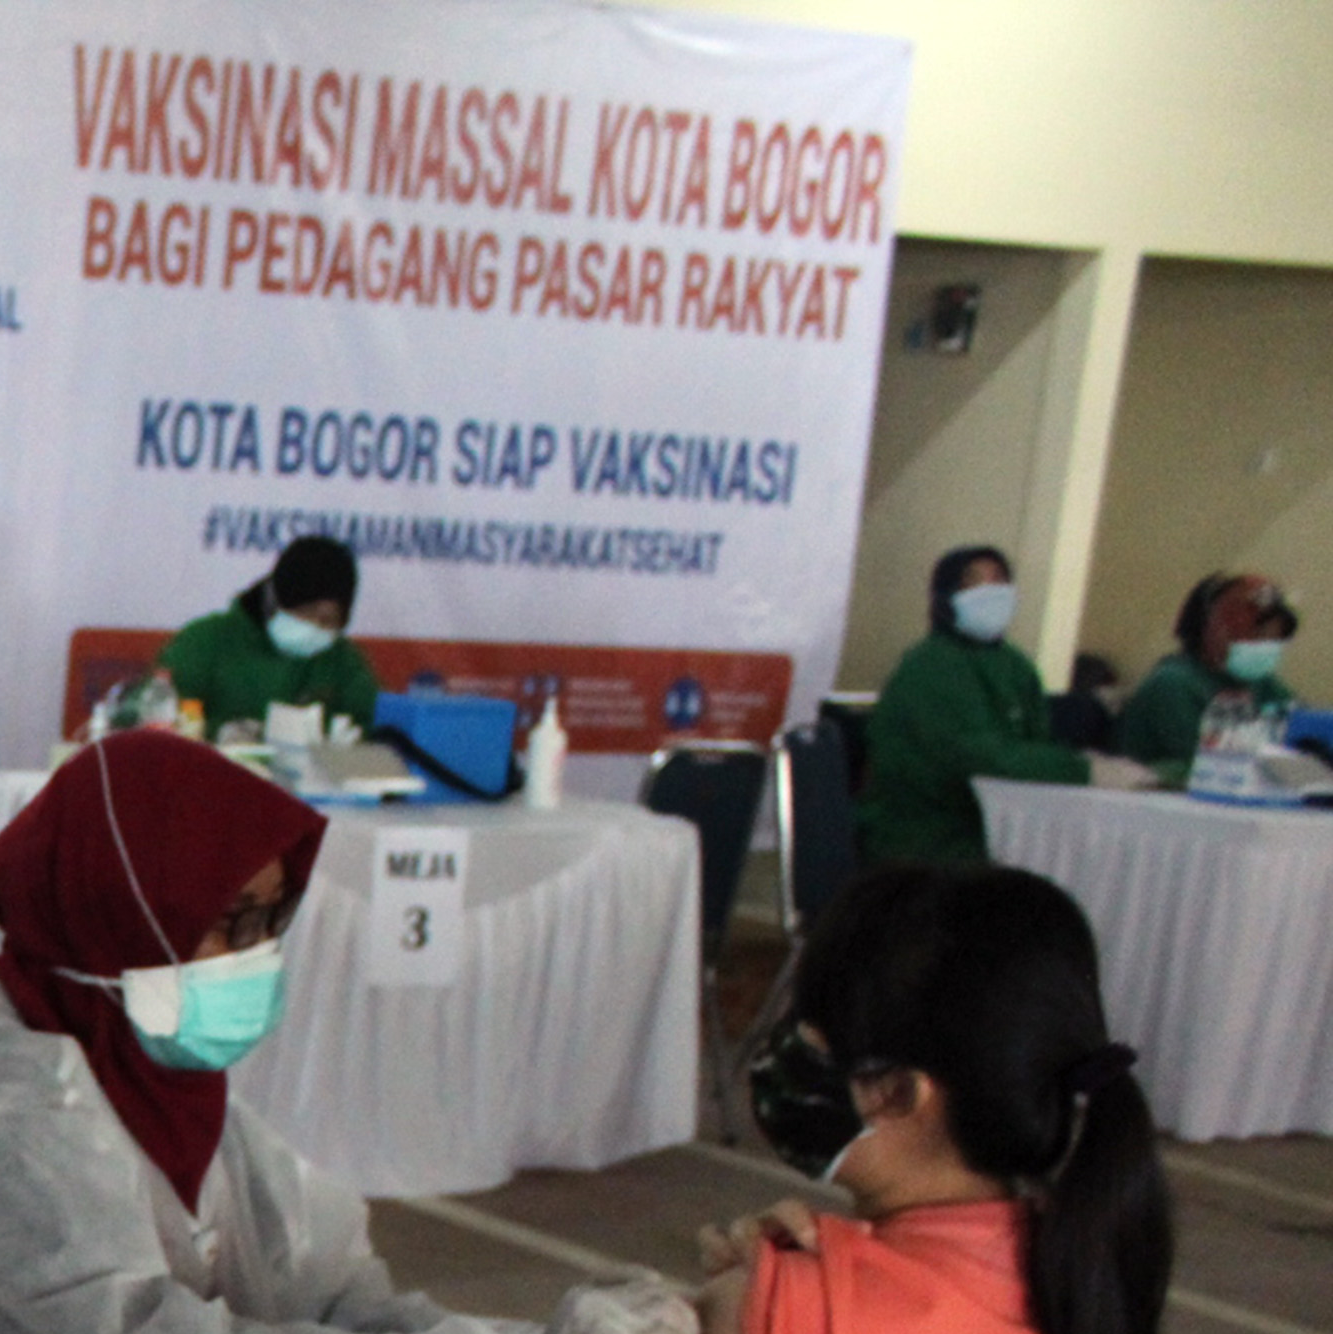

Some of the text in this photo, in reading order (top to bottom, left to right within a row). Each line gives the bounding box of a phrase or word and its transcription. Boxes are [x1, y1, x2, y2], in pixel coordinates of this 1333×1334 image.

[73, 42, 888, 246] VAKSINASI MASSAL KOTA BOGOR
[80, 195, 861, 342] BAGI PEDAGANG PASAR RAKYAT
[135, 398, 798, 507] KOTA BOGOR SIAP VAKSINASI
[386, 849, 458, 882] MEJA
[399, 906, 430, 951] 3
